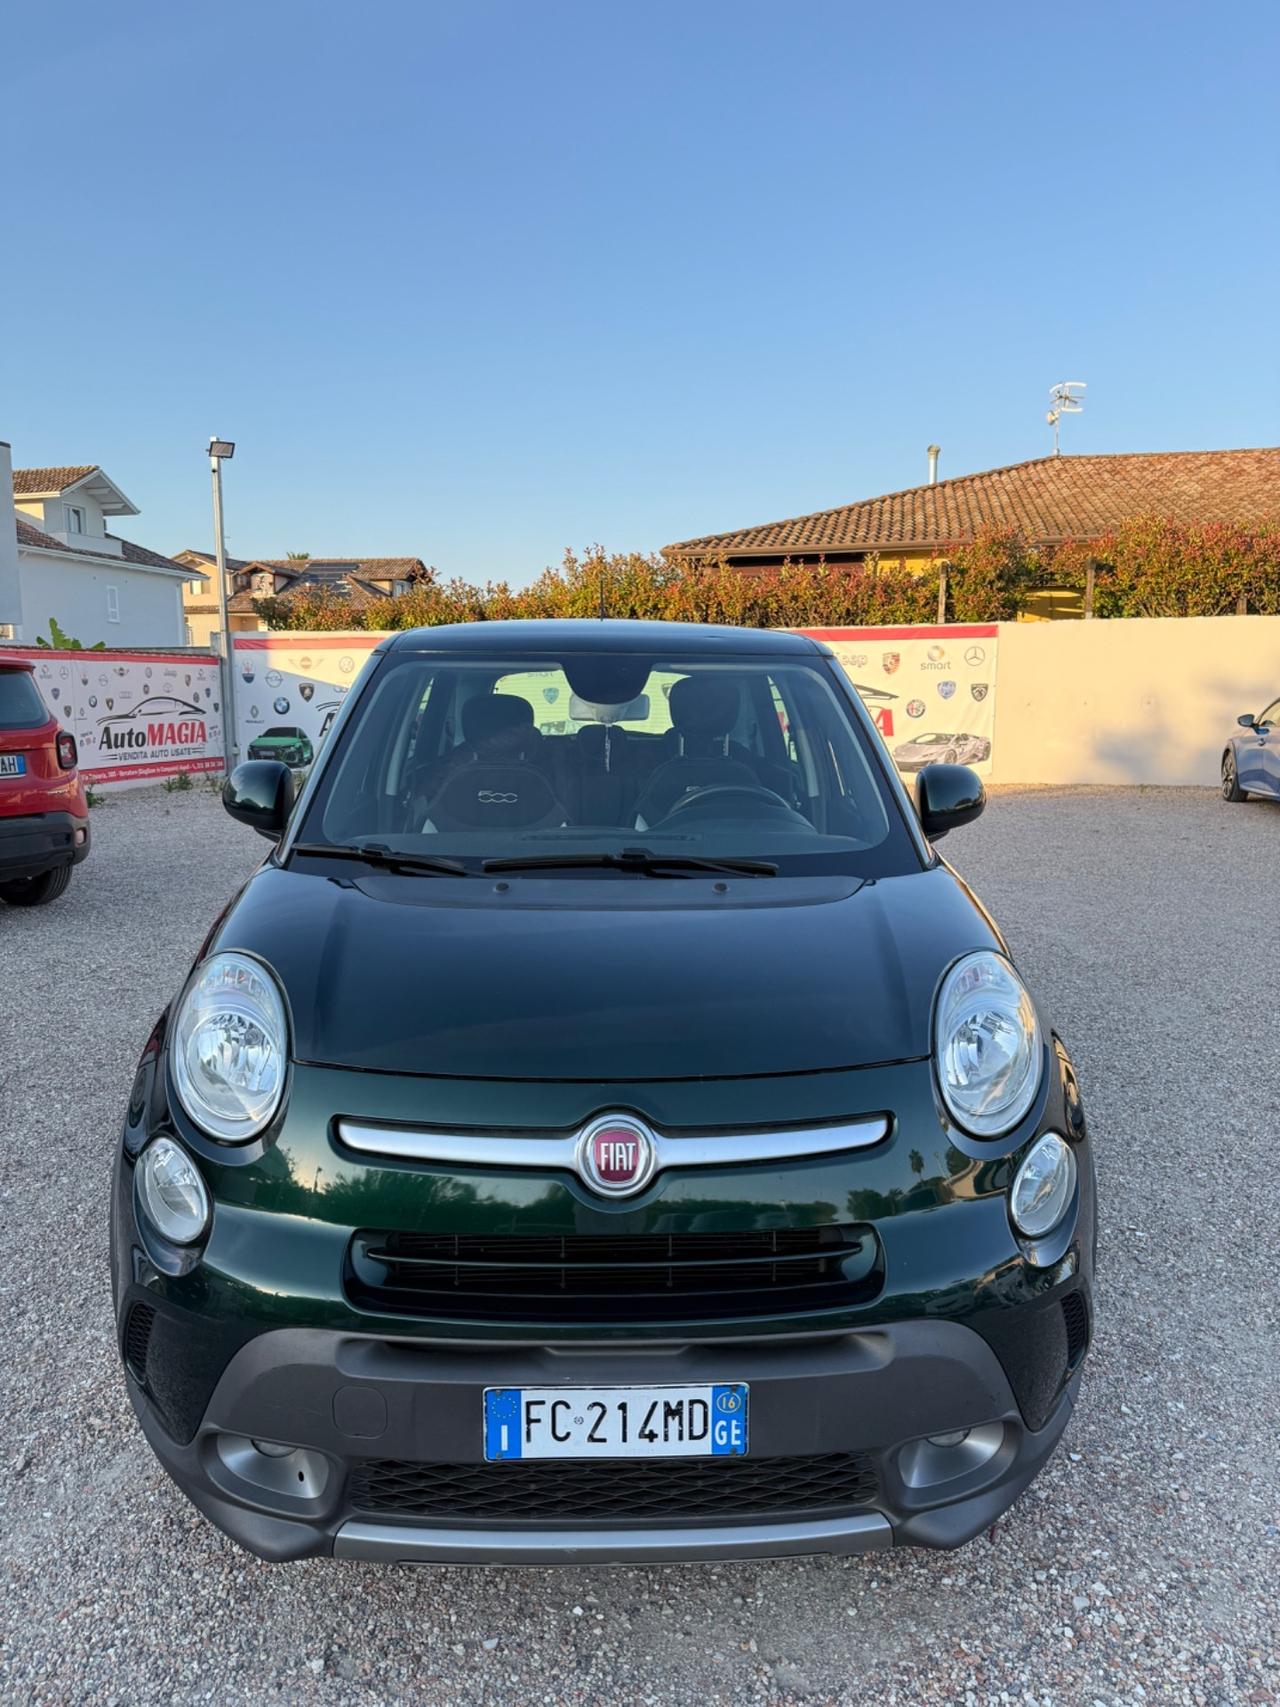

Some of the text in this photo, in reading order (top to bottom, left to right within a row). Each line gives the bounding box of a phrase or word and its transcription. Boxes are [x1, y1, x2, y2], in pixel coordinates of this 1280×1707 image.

[920, 661, 951, 671] smart
[99, 721, 206, 750] AutoMAGIA
[118, 747, 191, 761] VENDITA AUTO USATE
[600, 1143, 636, 1171] FIAT
[721, 1396, 736, 1410] 16
[714, 1420, 741, 1446] GE
